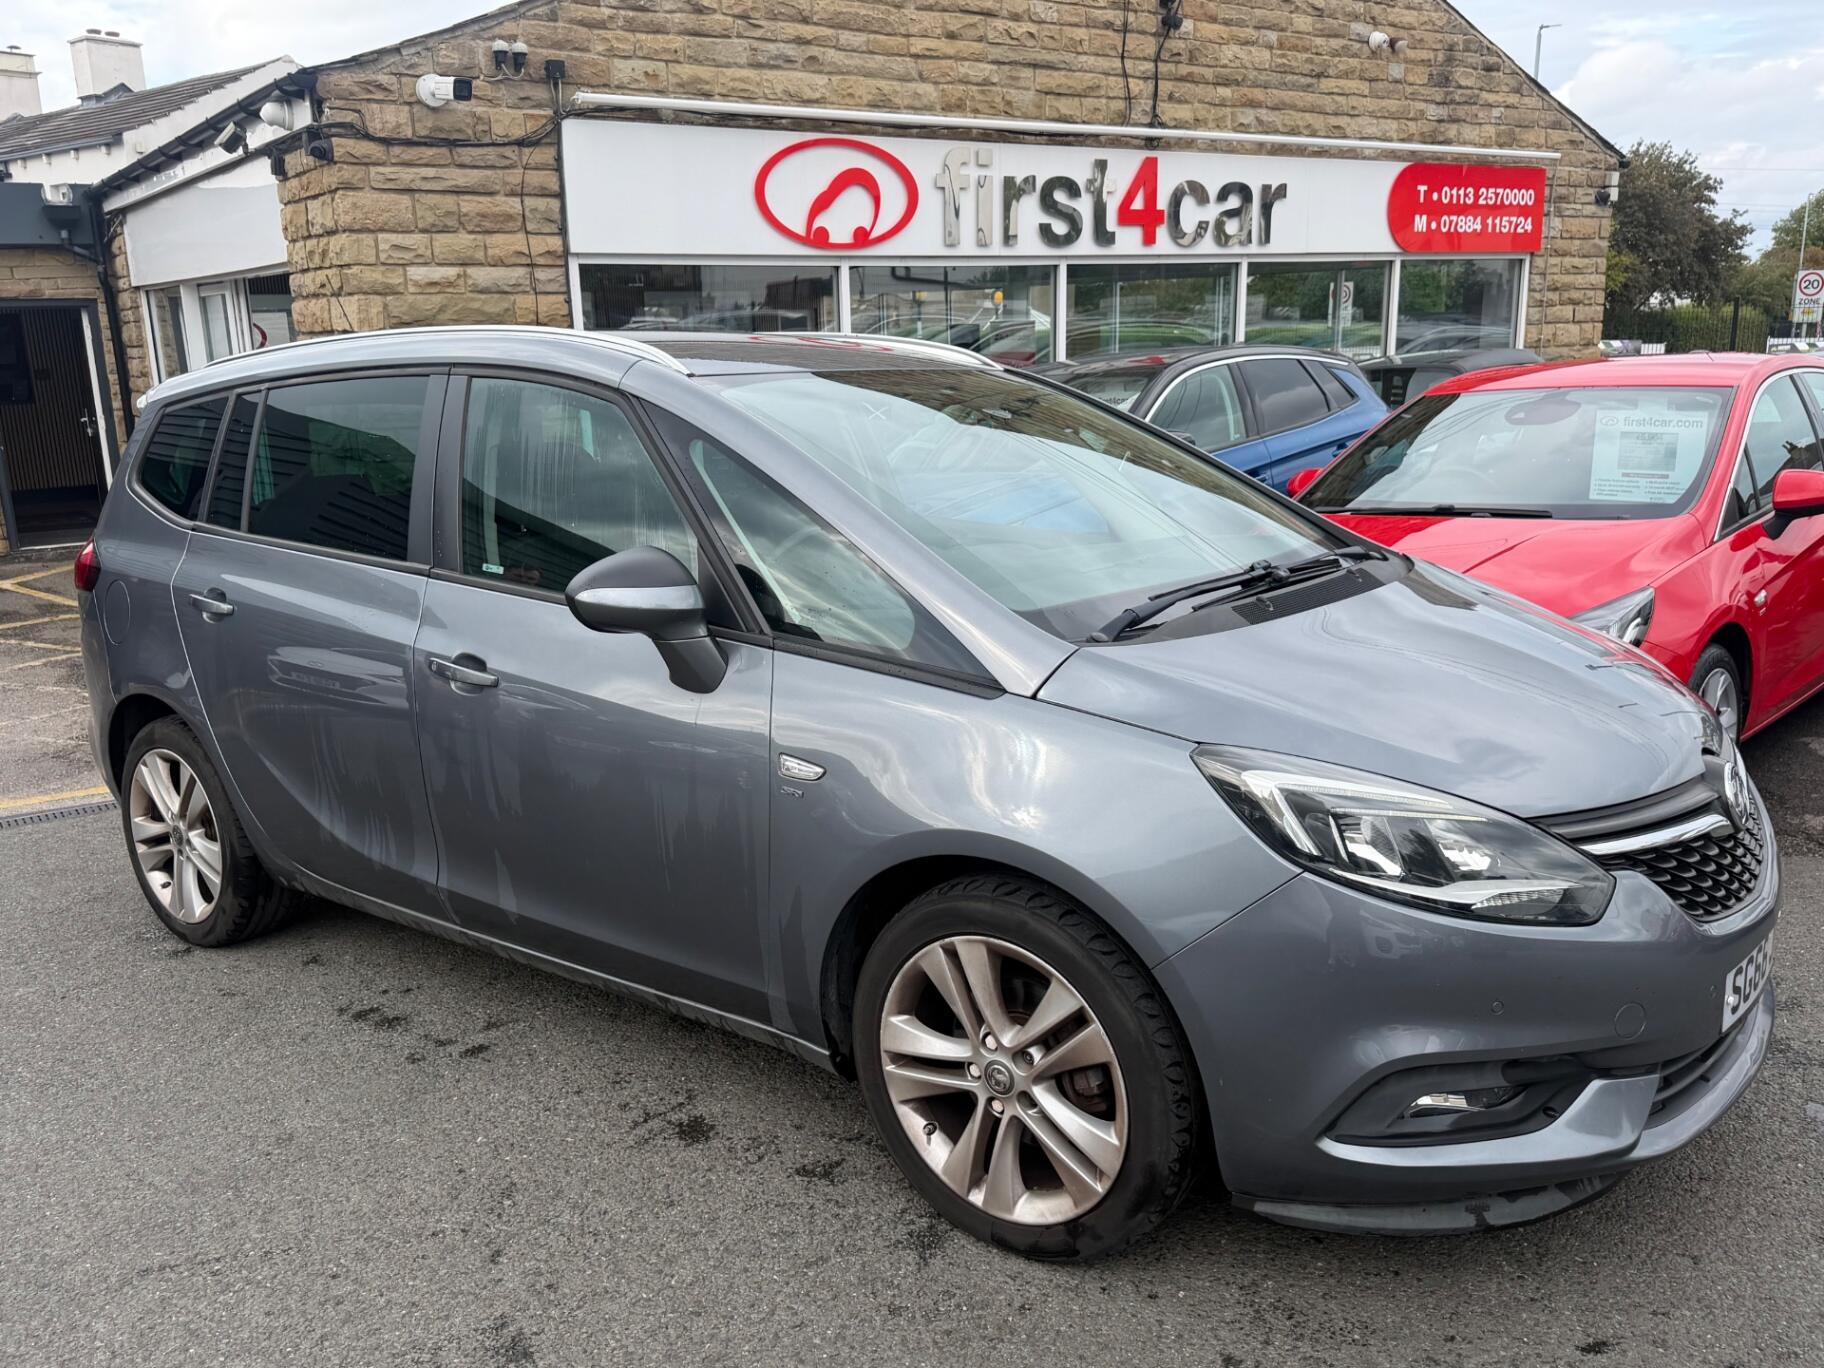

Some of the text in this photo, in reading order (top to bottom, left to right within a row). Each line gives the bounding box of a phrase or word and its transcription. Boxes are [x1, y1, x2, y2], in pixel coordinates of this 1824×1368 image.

[935, 147, 1288, 248] first4car
[1416, 185, 1535, 206] T 0113 2570000
[1413, 214, 1533, 233] M 07884 115724
[1803, 279, 1820, 290] 20
[1623, 416, 1704, 429] first4car.com
